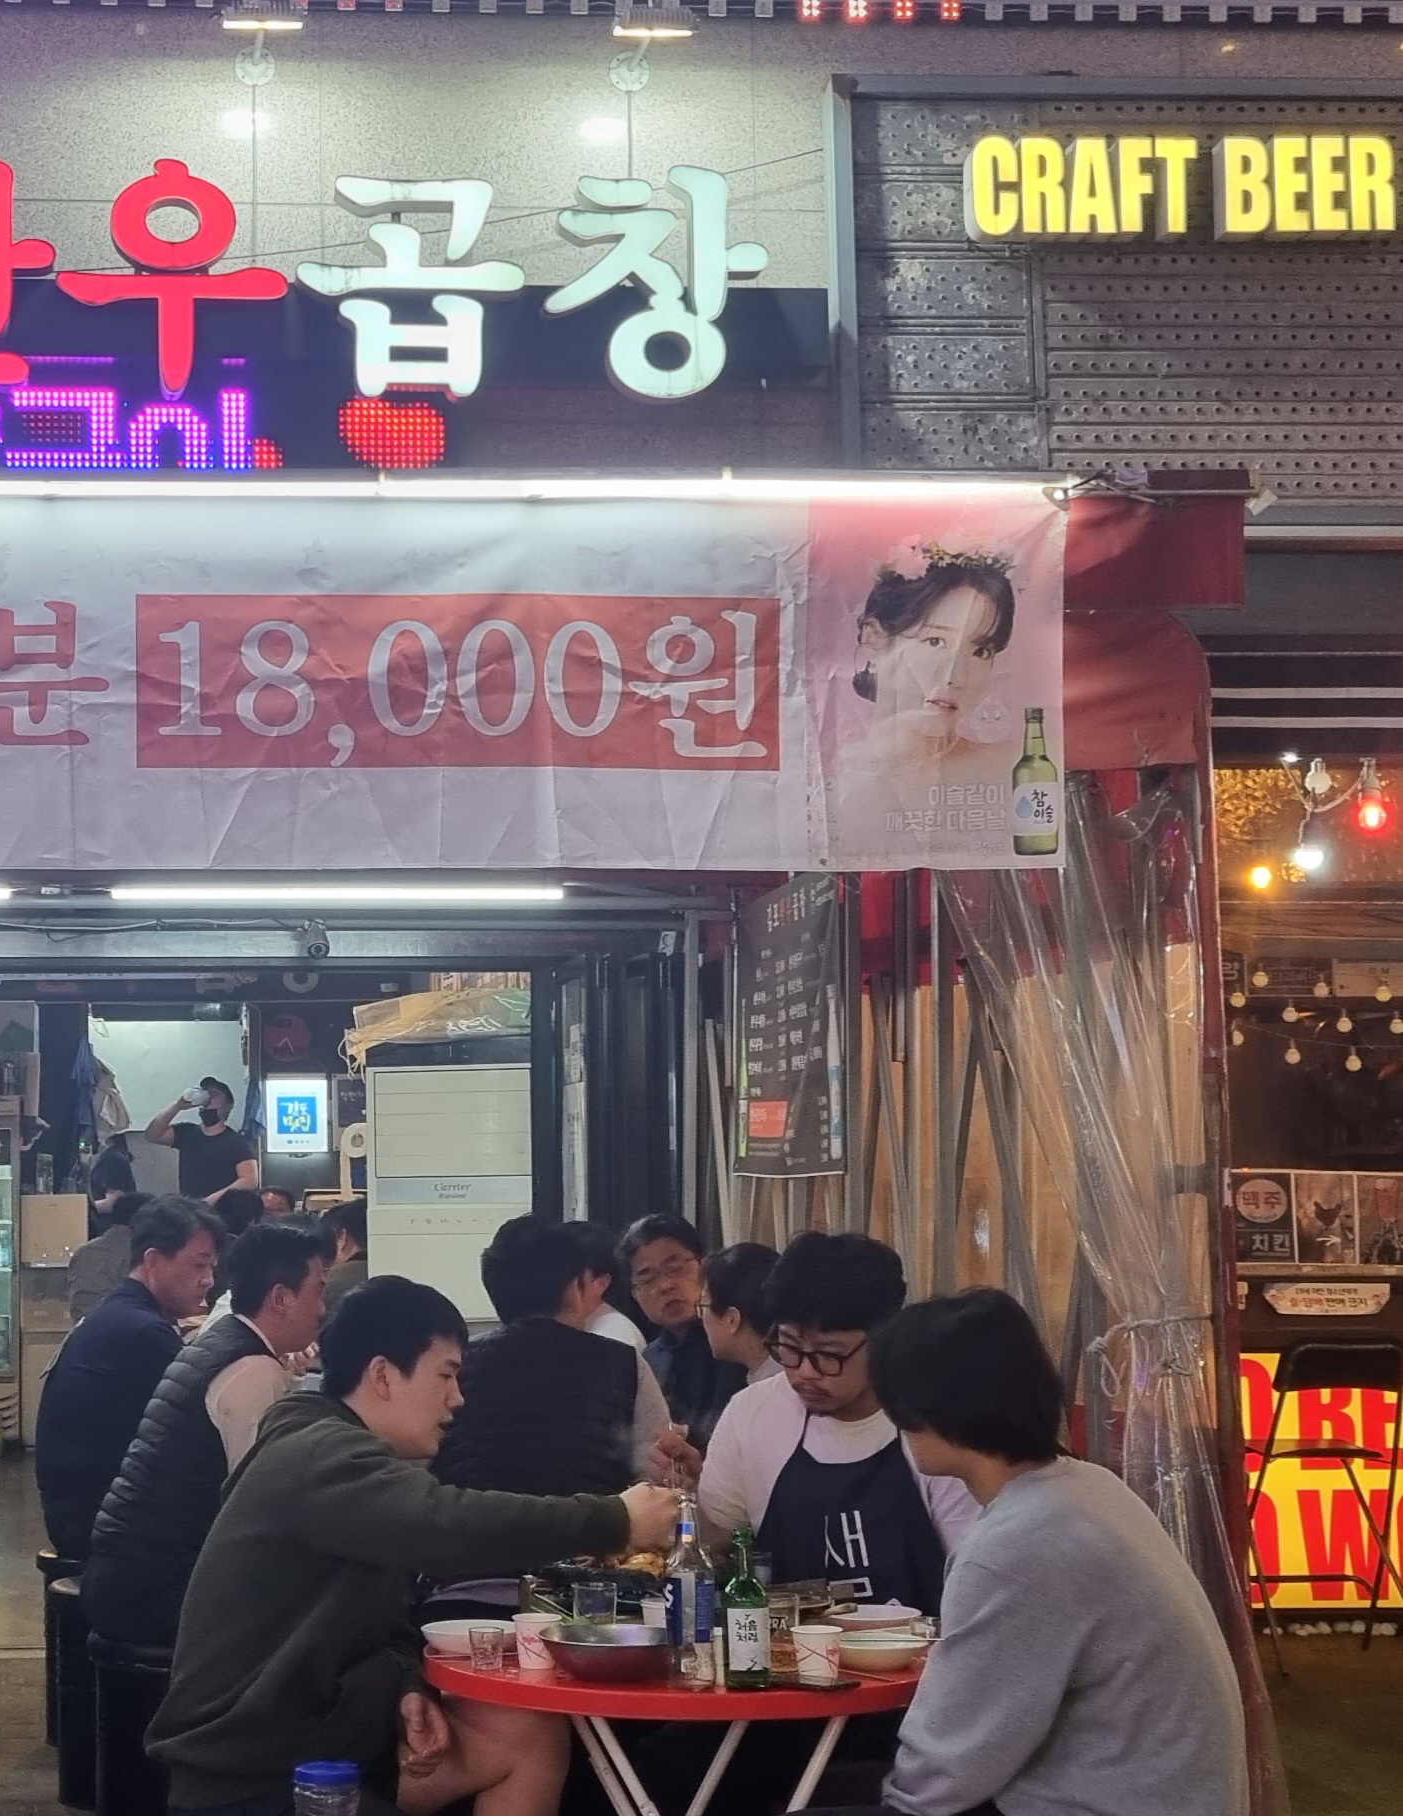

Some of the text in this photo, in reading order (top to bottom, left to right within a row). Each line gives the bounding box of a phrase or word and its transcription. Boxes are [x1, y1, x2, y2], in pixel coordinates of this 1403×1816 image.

[965, 135, 1397, 239] CRAFT BEER
[156, 608, 769, 768] 18,000원
[928, 783, 1006, 808] 이슬같이
[1031, 789, 1049, 808] 참
[947, 809, 1007, 832] 다음날
[433, 1182, 472, 1192] Carrier
[1251, 1232, 1291, 1252] 치킨
[735, 1619, 758, 1632] 처음
[735, 1632, 759, 1643] 처럼
